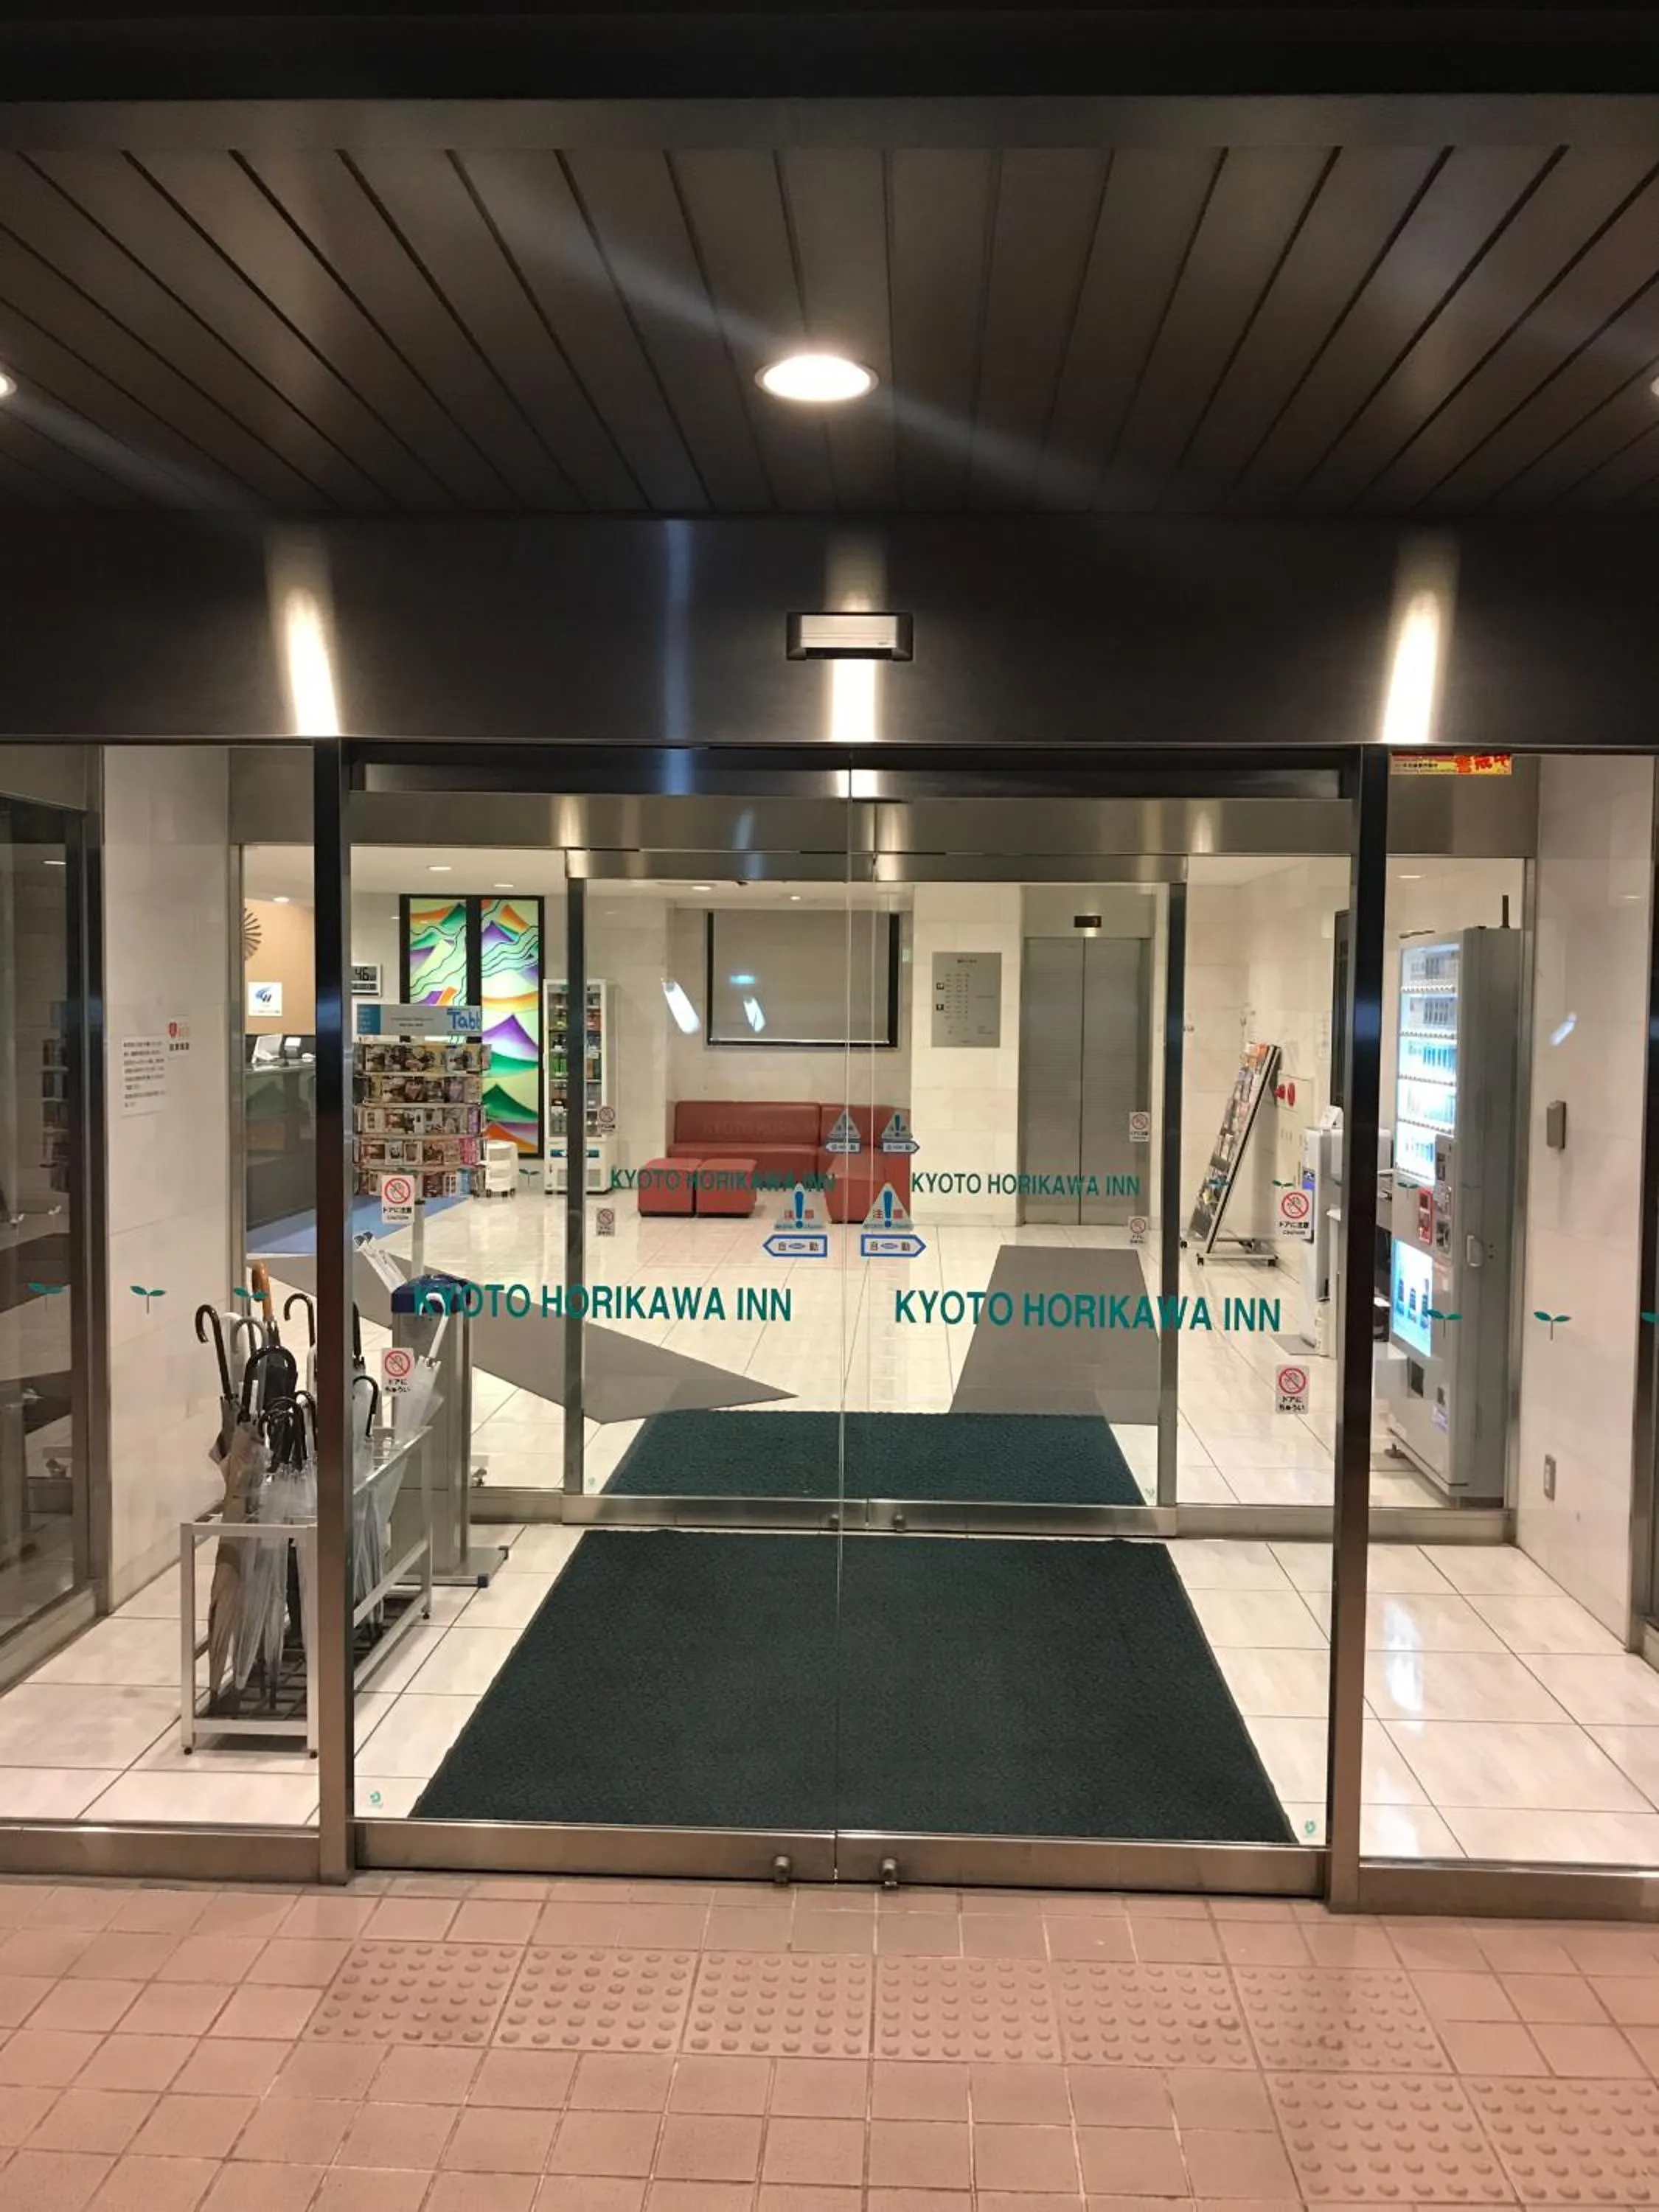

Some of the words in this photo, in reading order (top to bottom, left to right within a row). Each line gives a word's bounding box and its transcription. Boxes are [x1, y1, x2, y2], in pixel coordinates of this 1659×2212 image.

[611, 1167, 681, 1190] KYOTO
[911, 1172, 982, 1194] KYOTO
[987, 1174, 1099, 1195] HORIKAWA
[1106, 1175, 1140, 1196] INN
[413, 1282, 532, 1318] KYOTO
[540, 1284, 726, 1320] HORIKAWA
[737, 1287, 792, 1321] INN
[895, 1290, 1014, 1326] KYOTO
[1023, 1292, 1213, 1330] HORIKAWA
[1223, 1297, 1281, 1332] INN
